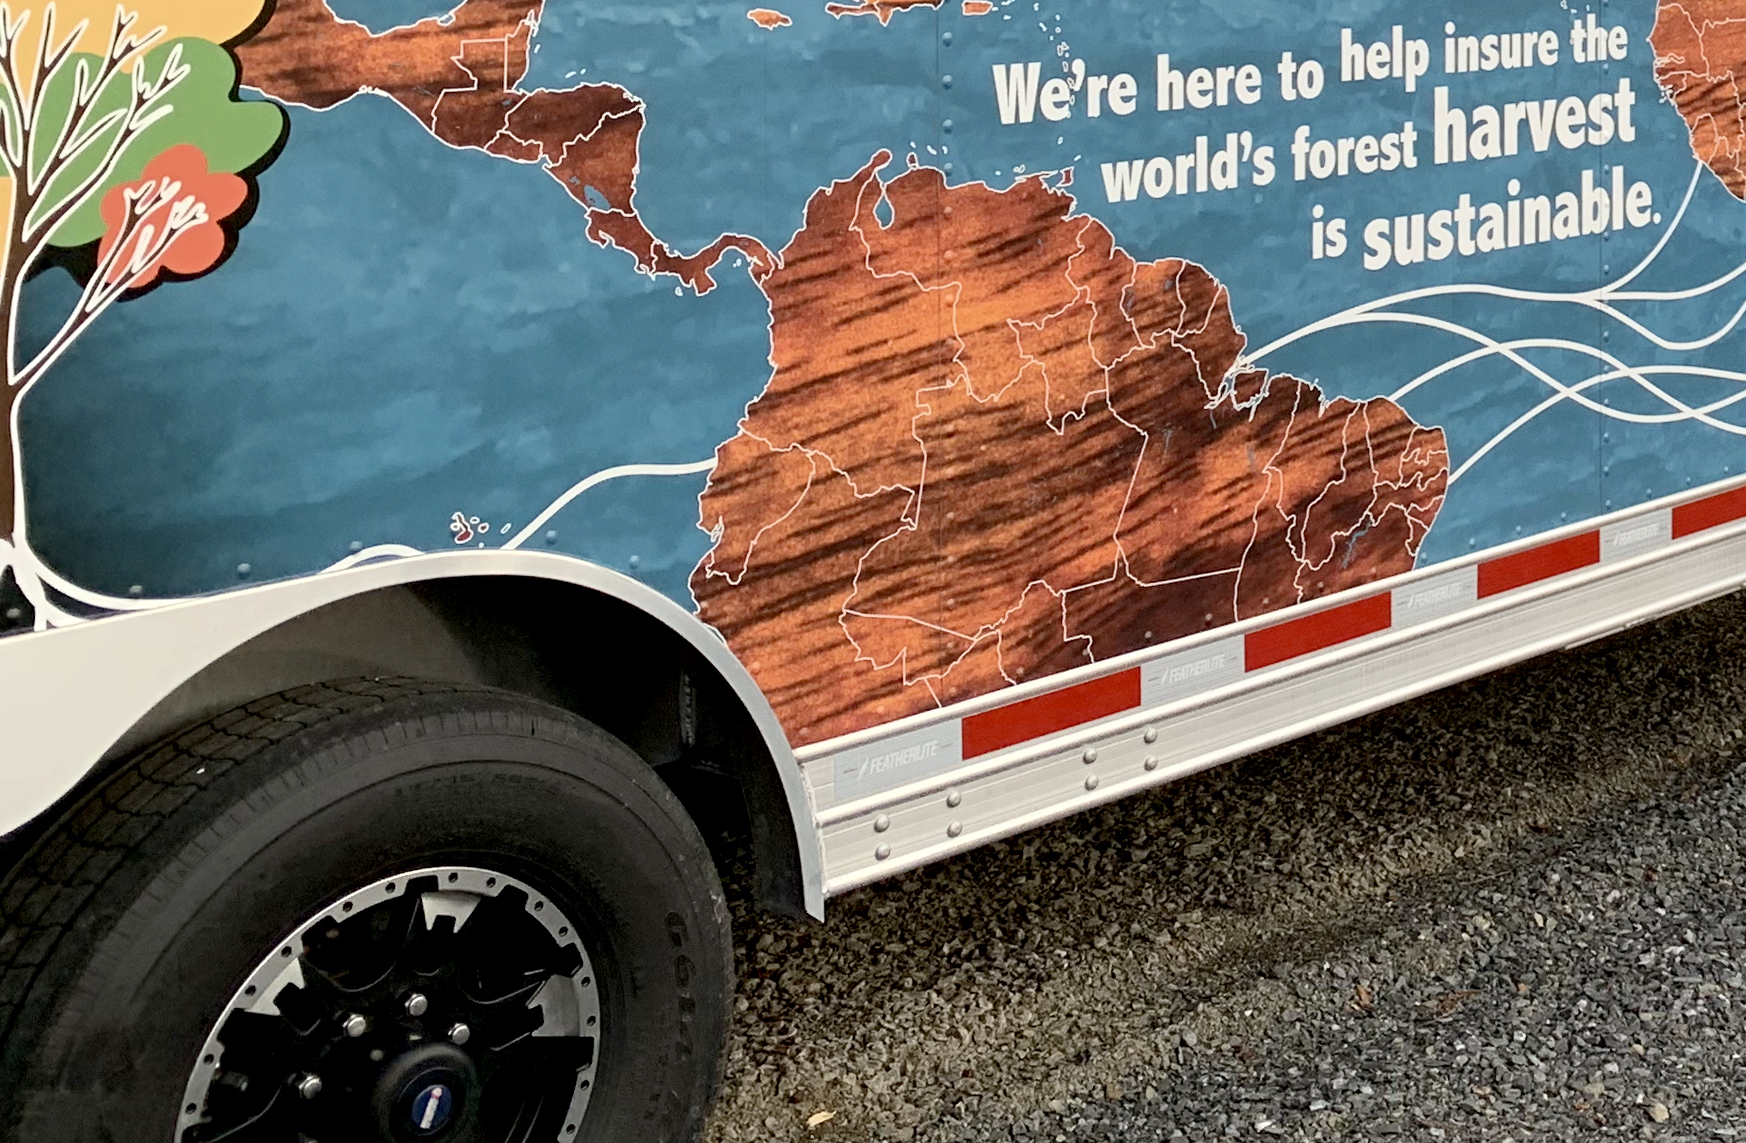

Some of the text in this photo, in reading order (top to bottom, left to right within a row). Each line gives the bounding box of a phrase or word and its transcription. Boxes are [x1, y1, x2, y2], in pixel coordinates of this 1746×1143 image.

[993, 13, 1628, 125] We're here to help insure the
[1100, 77, 1636, 203] world's forest harvest
[1312, 165, 1662, 271] is sustainable.
[869, 739, 939, 775] FEATHERLITE
